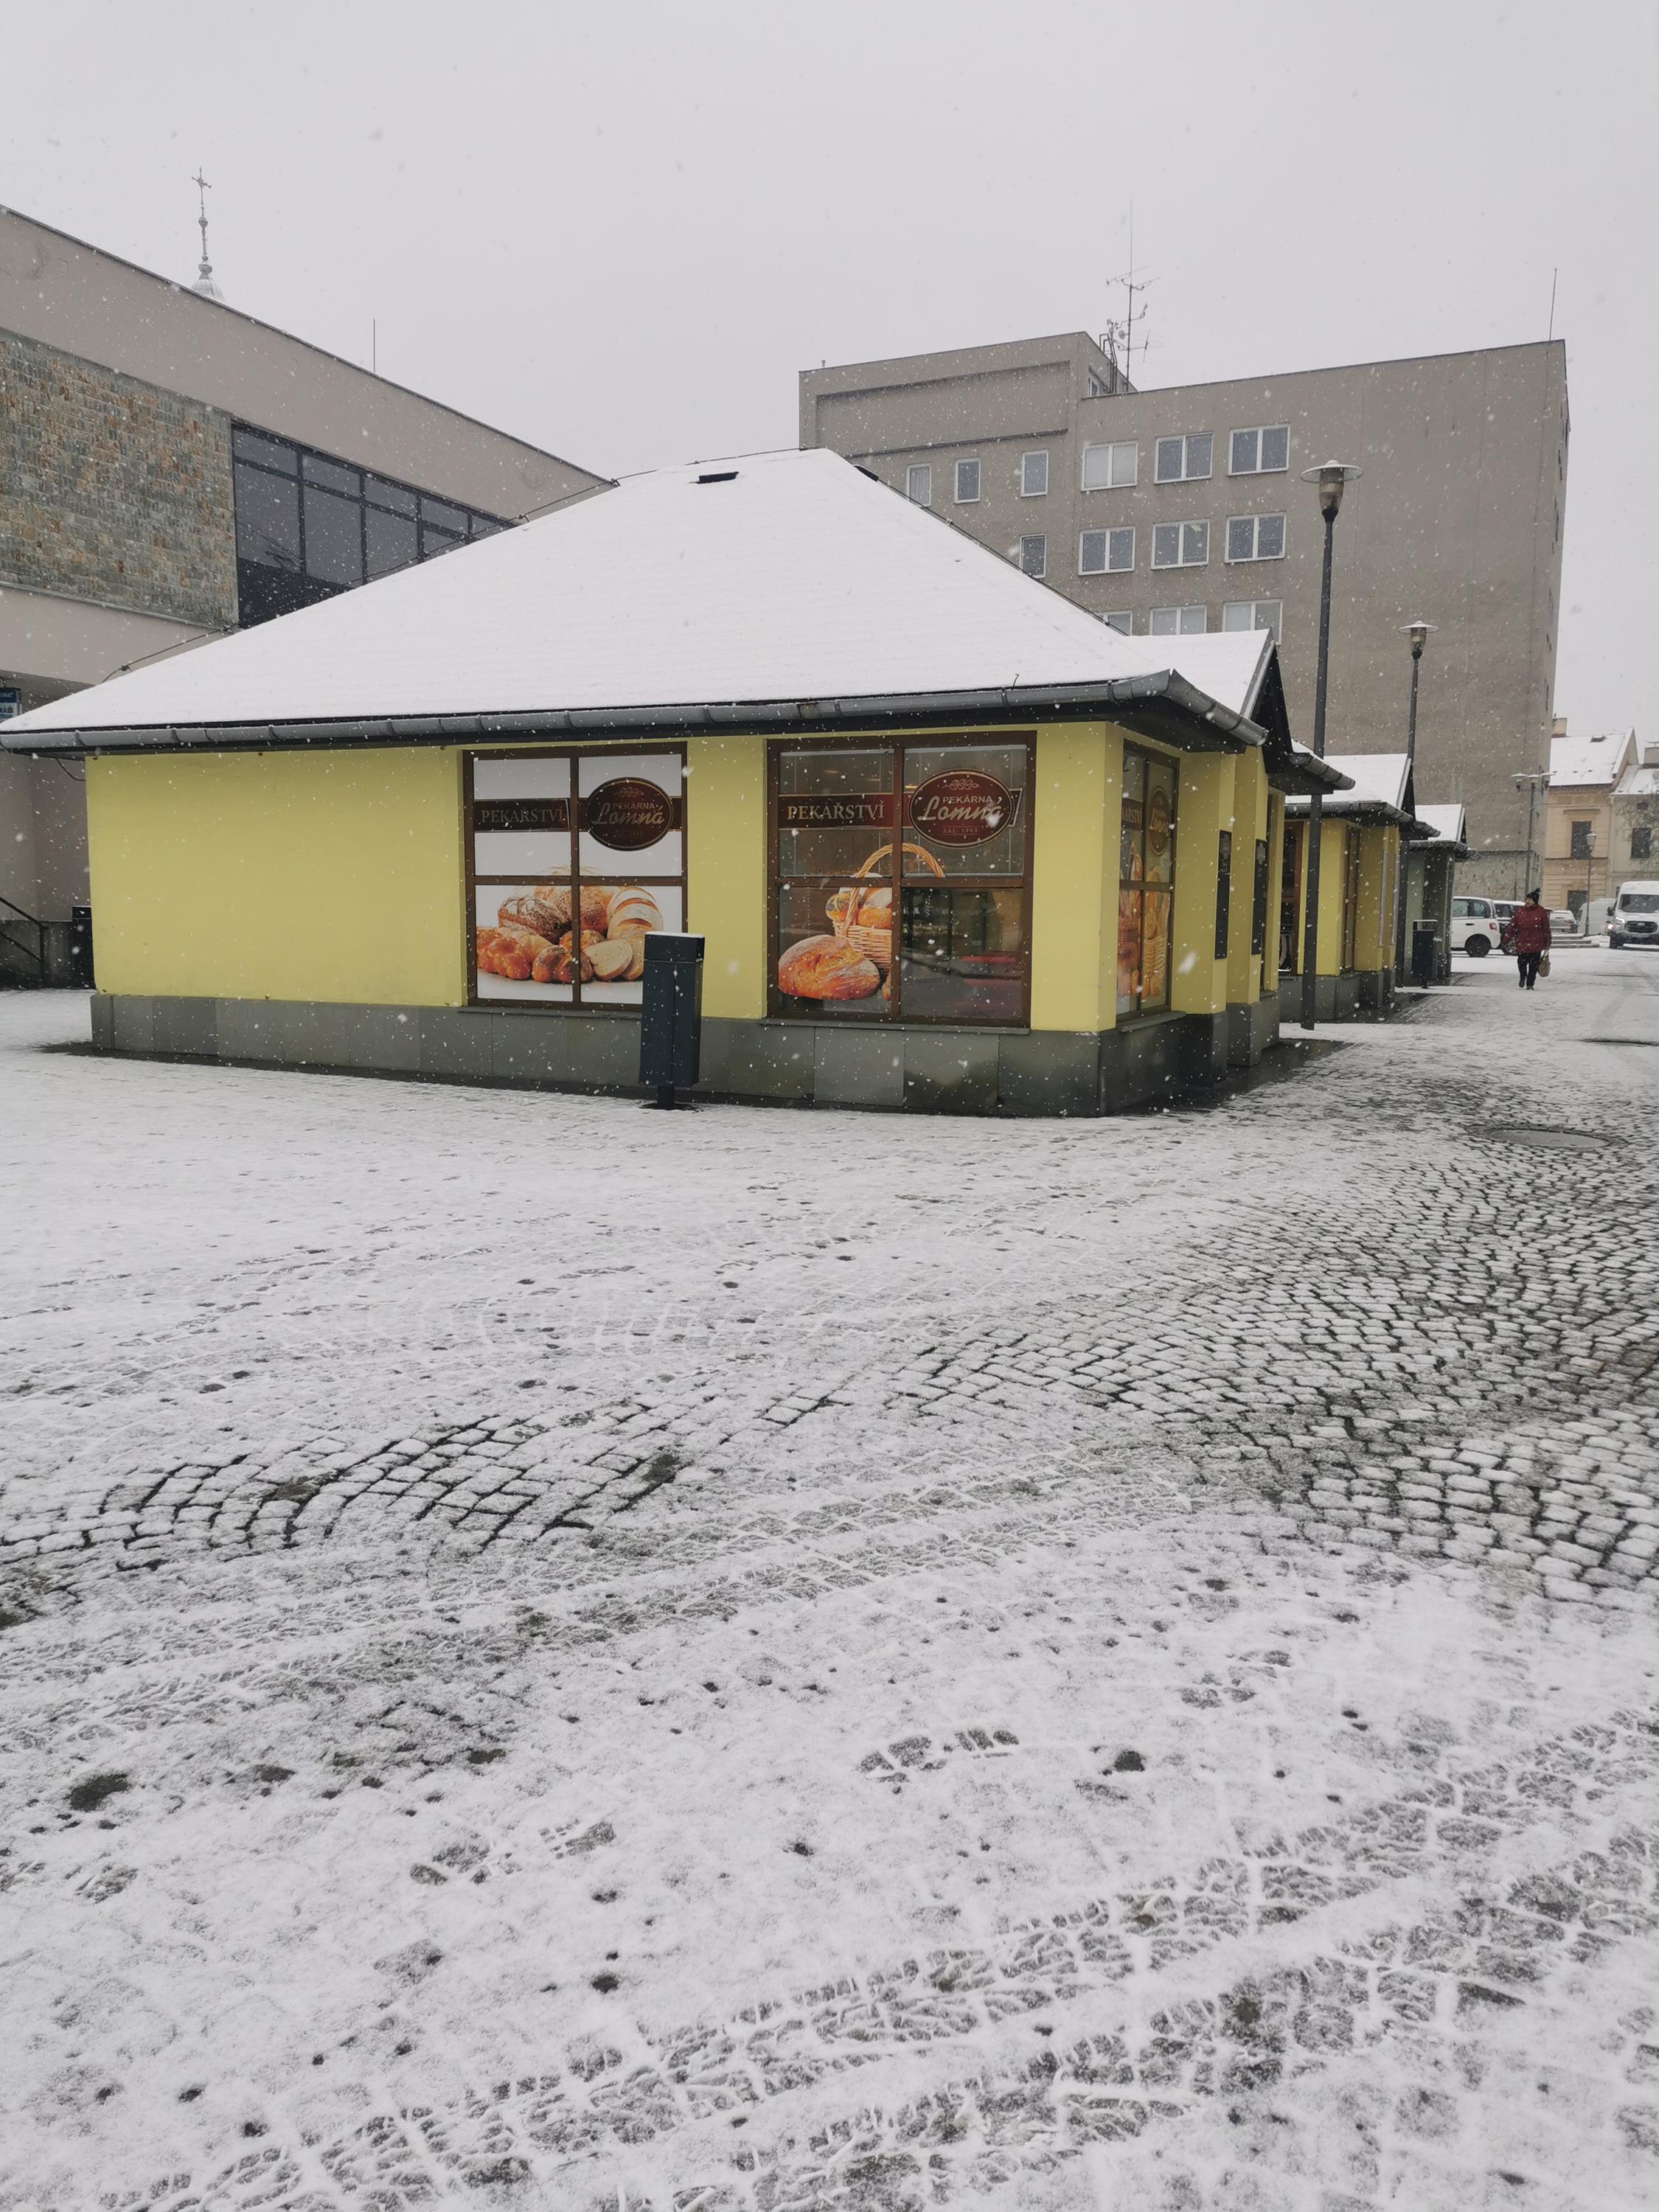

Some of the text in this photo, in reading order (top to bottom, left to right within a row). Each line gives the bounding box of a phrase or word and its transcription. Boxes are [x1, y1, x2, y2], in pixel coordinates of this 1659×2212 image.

[787, 799, 885, 820] PEKAŘSTVÍ
[917, 796, 1004, 821] Lomná
[942, 794, 993, 804] PEKÁRNA
[481, 806, 563, 823] PEKAŘSTVÍ
[591, 802, 664, 824] Lomná
